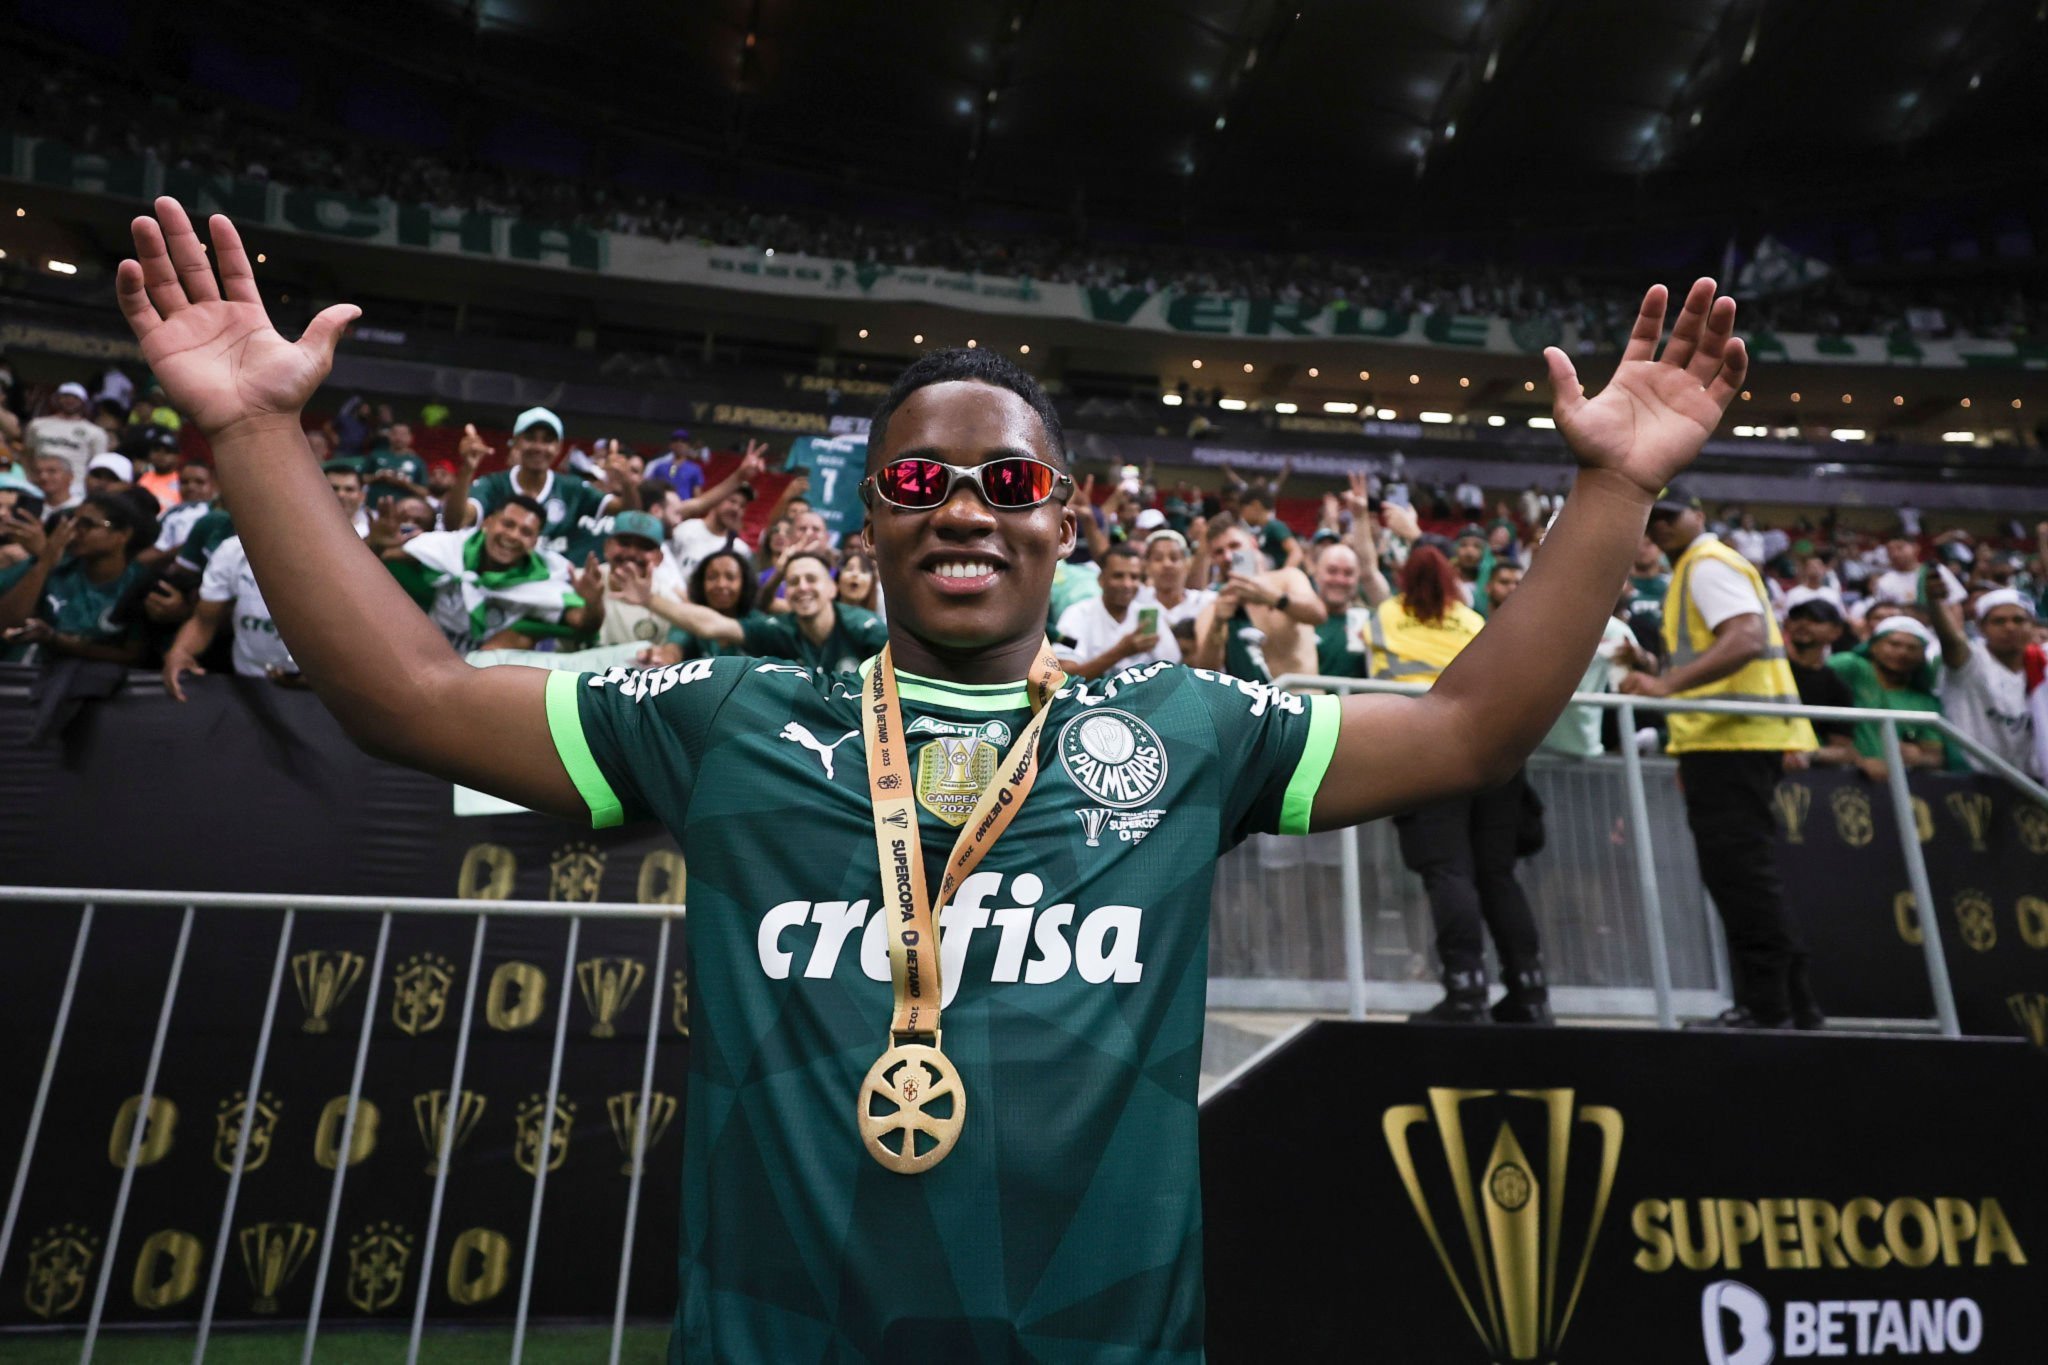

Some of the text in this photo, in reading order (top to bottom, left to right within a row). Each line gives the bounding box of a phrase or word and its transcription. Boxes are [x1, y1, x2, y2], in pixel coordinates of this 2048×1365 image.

[0, 133, 603, 272] ANCHA
[1086, 286, 1490, 346] VERDE
[875, 714, 888, 743] BETANO
[913, 718, 978, 738] AVANTI
[881, 748, 891, 767] 2023
[1068, 746, 1160, 801] PALMEIRAS
[926, 792, 981, 803] CAMPEÃ
[940, 804, 975, 814] 2022
[974, 804, 1002, 843] BETANO
[1109, 818, 1161, 831] SUPERCO
[957, 845, 975, 868] 2023
[892, 839, 915, 923] SUPERCOPA
[906, 949, 921, 998] BETANO
[1630, 1197, 2029, 1273] SUPERCOPA
[1784, 1296, 1984, 1358] BETANO
